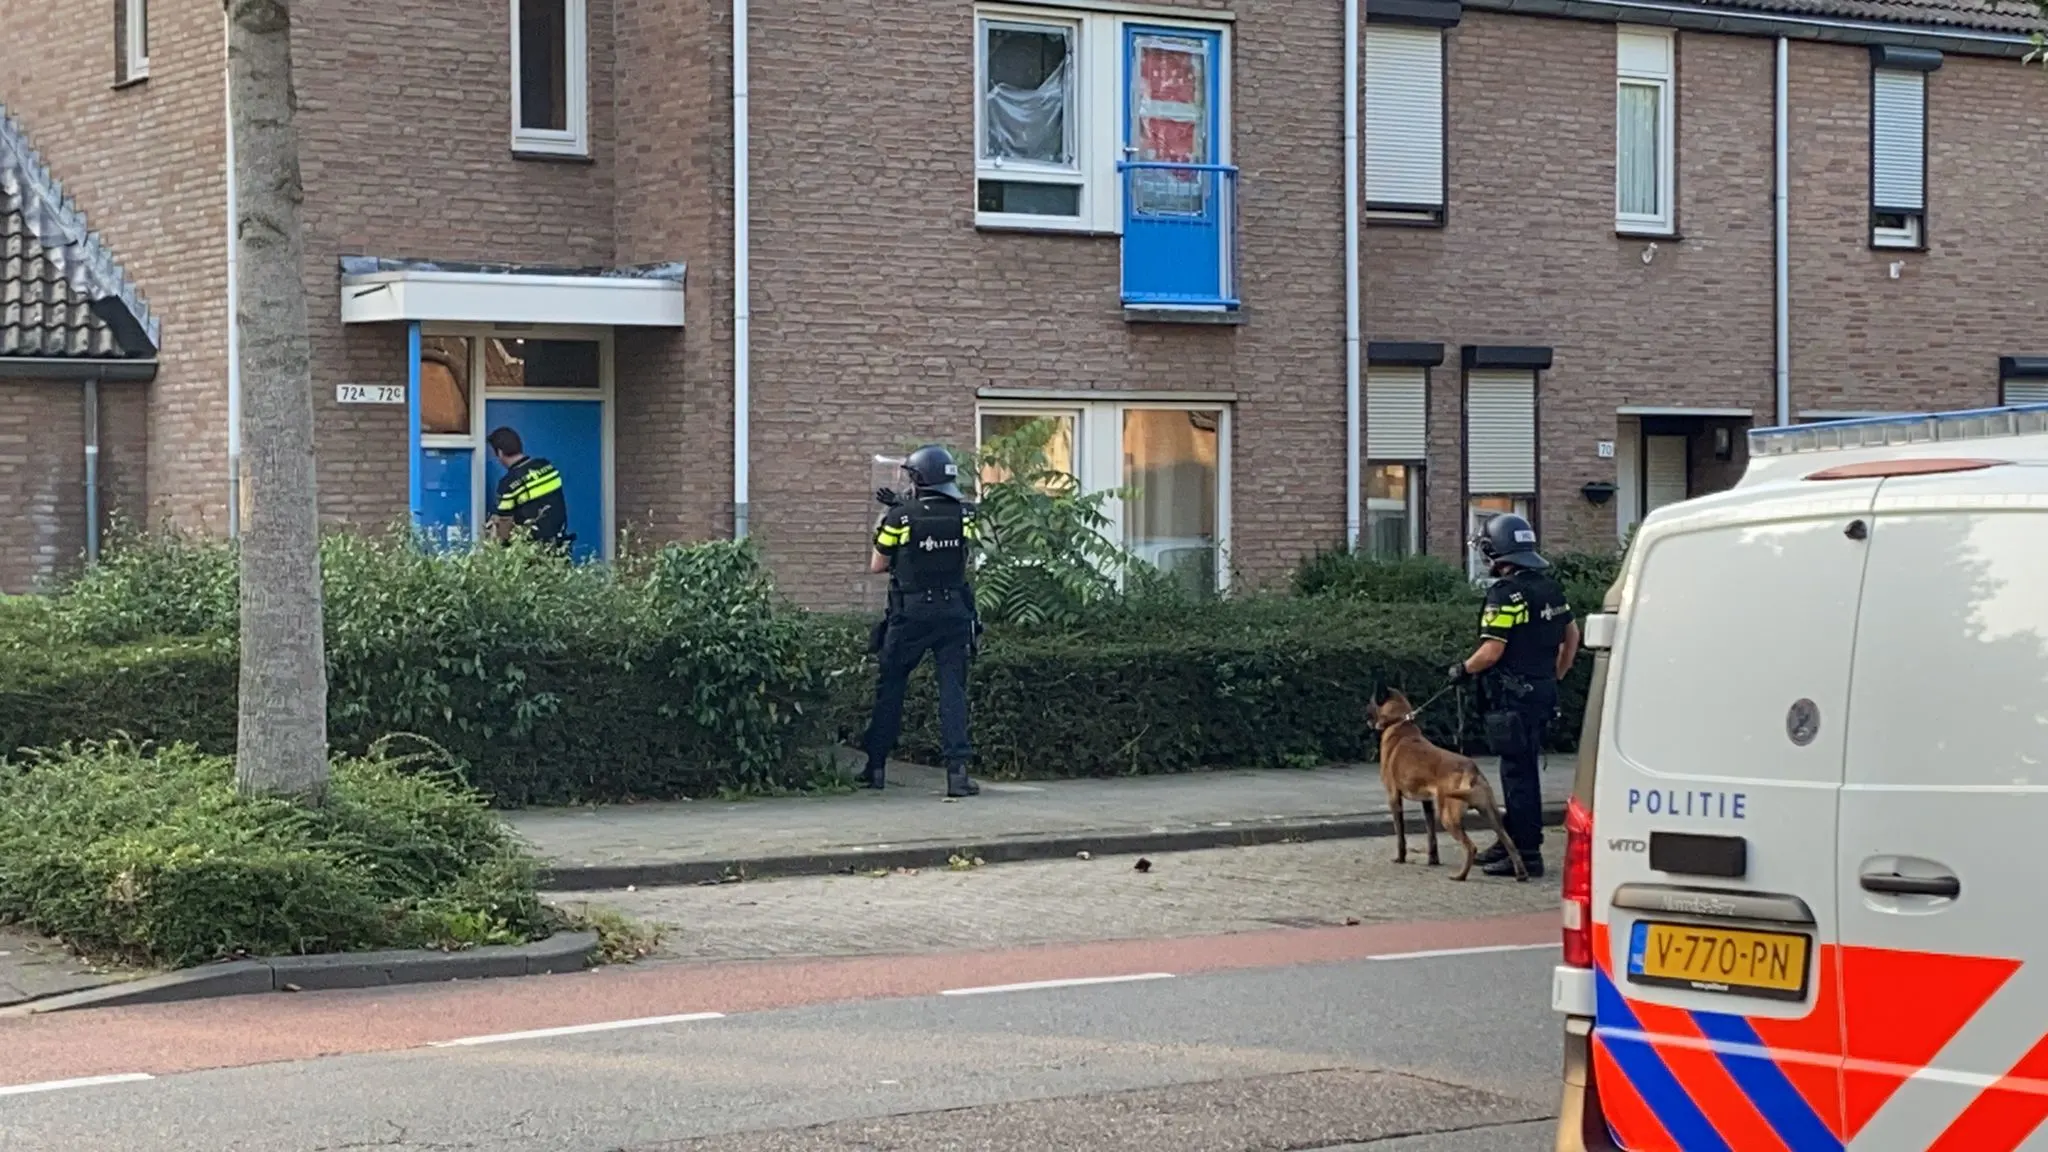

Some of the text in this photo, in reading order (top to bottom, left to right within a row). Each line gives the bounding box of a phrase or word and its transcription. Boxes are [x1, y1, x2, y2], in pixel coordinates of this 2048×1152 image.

[341, 386, 366, 401] 72A
[1600, 443, 1612, 456] 70
[1628, 789, 1746, 819] POLITIE
[1656, 932, 1790, 981] V-770-PN
